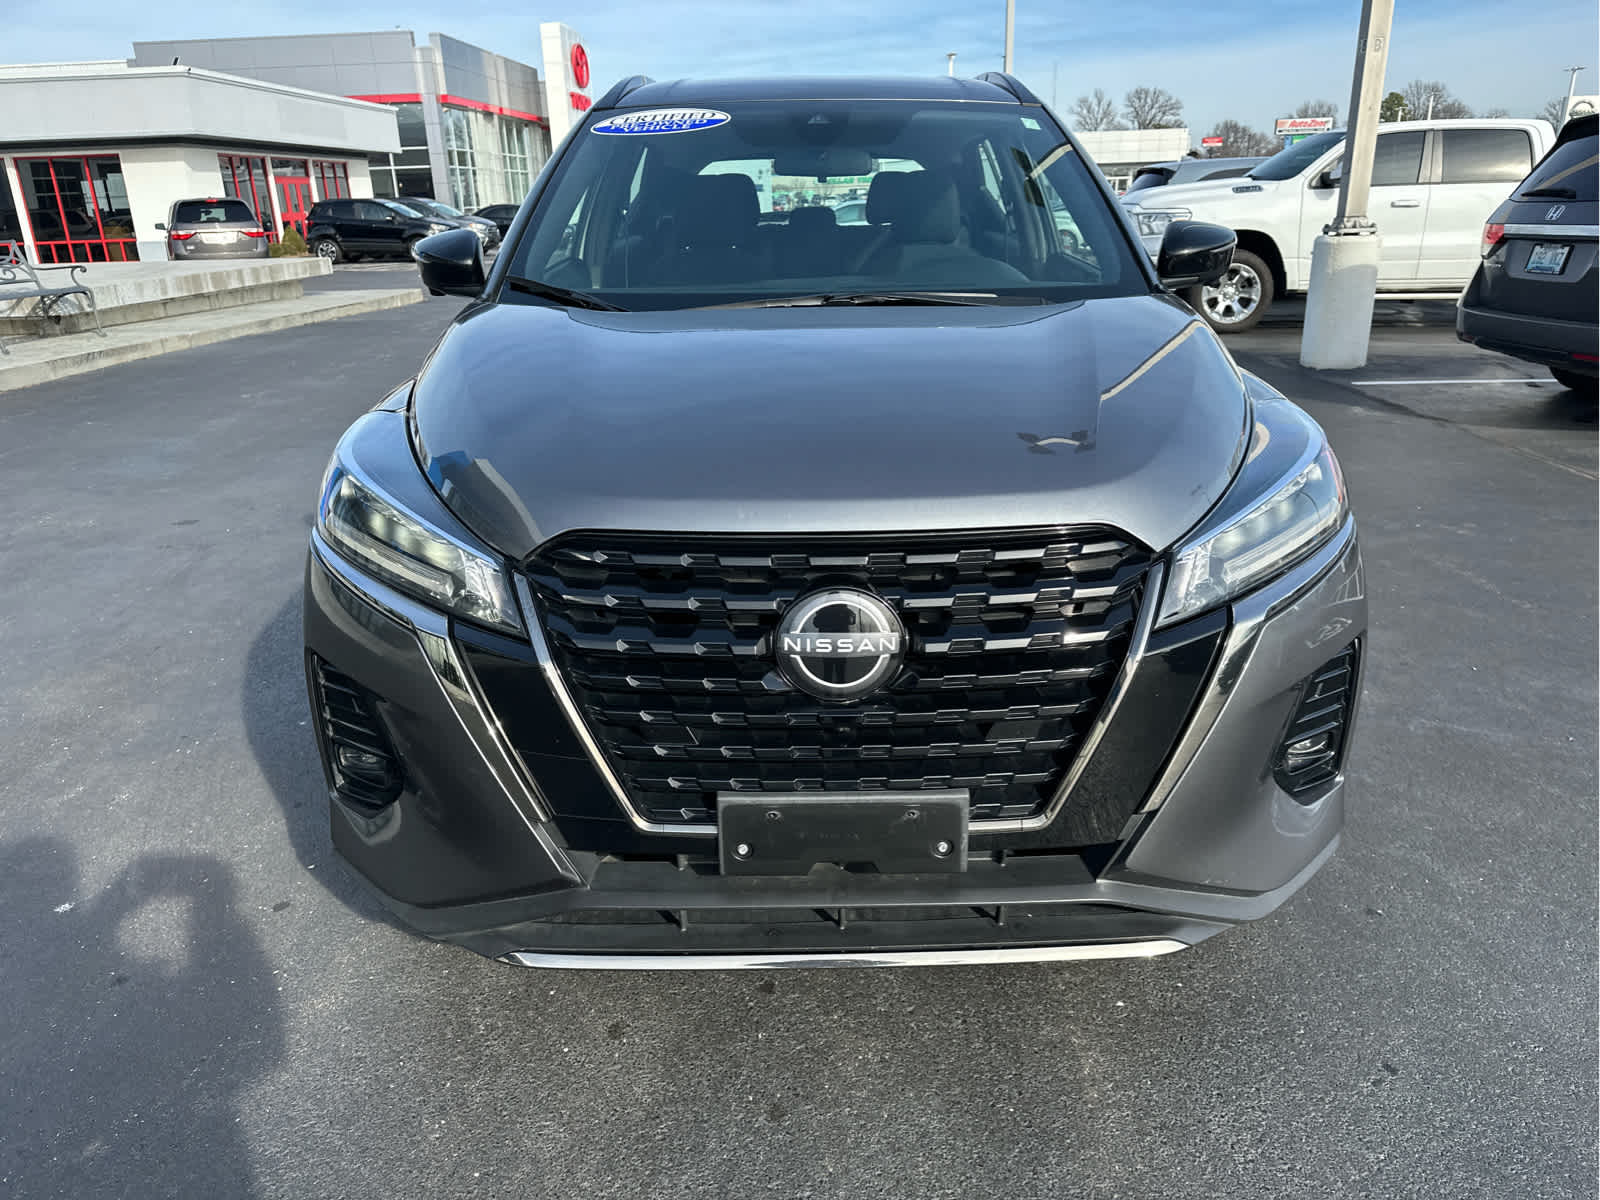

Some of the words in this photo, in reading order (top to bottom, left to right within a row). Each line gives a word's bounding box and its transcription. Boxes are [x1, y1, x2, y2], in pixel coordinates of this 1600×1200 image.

[609, 112, 716, 125] CERTIFIED
[623, 123, 692, 132] VEHICLE
[783, 637, 896, 652] NISSAN
